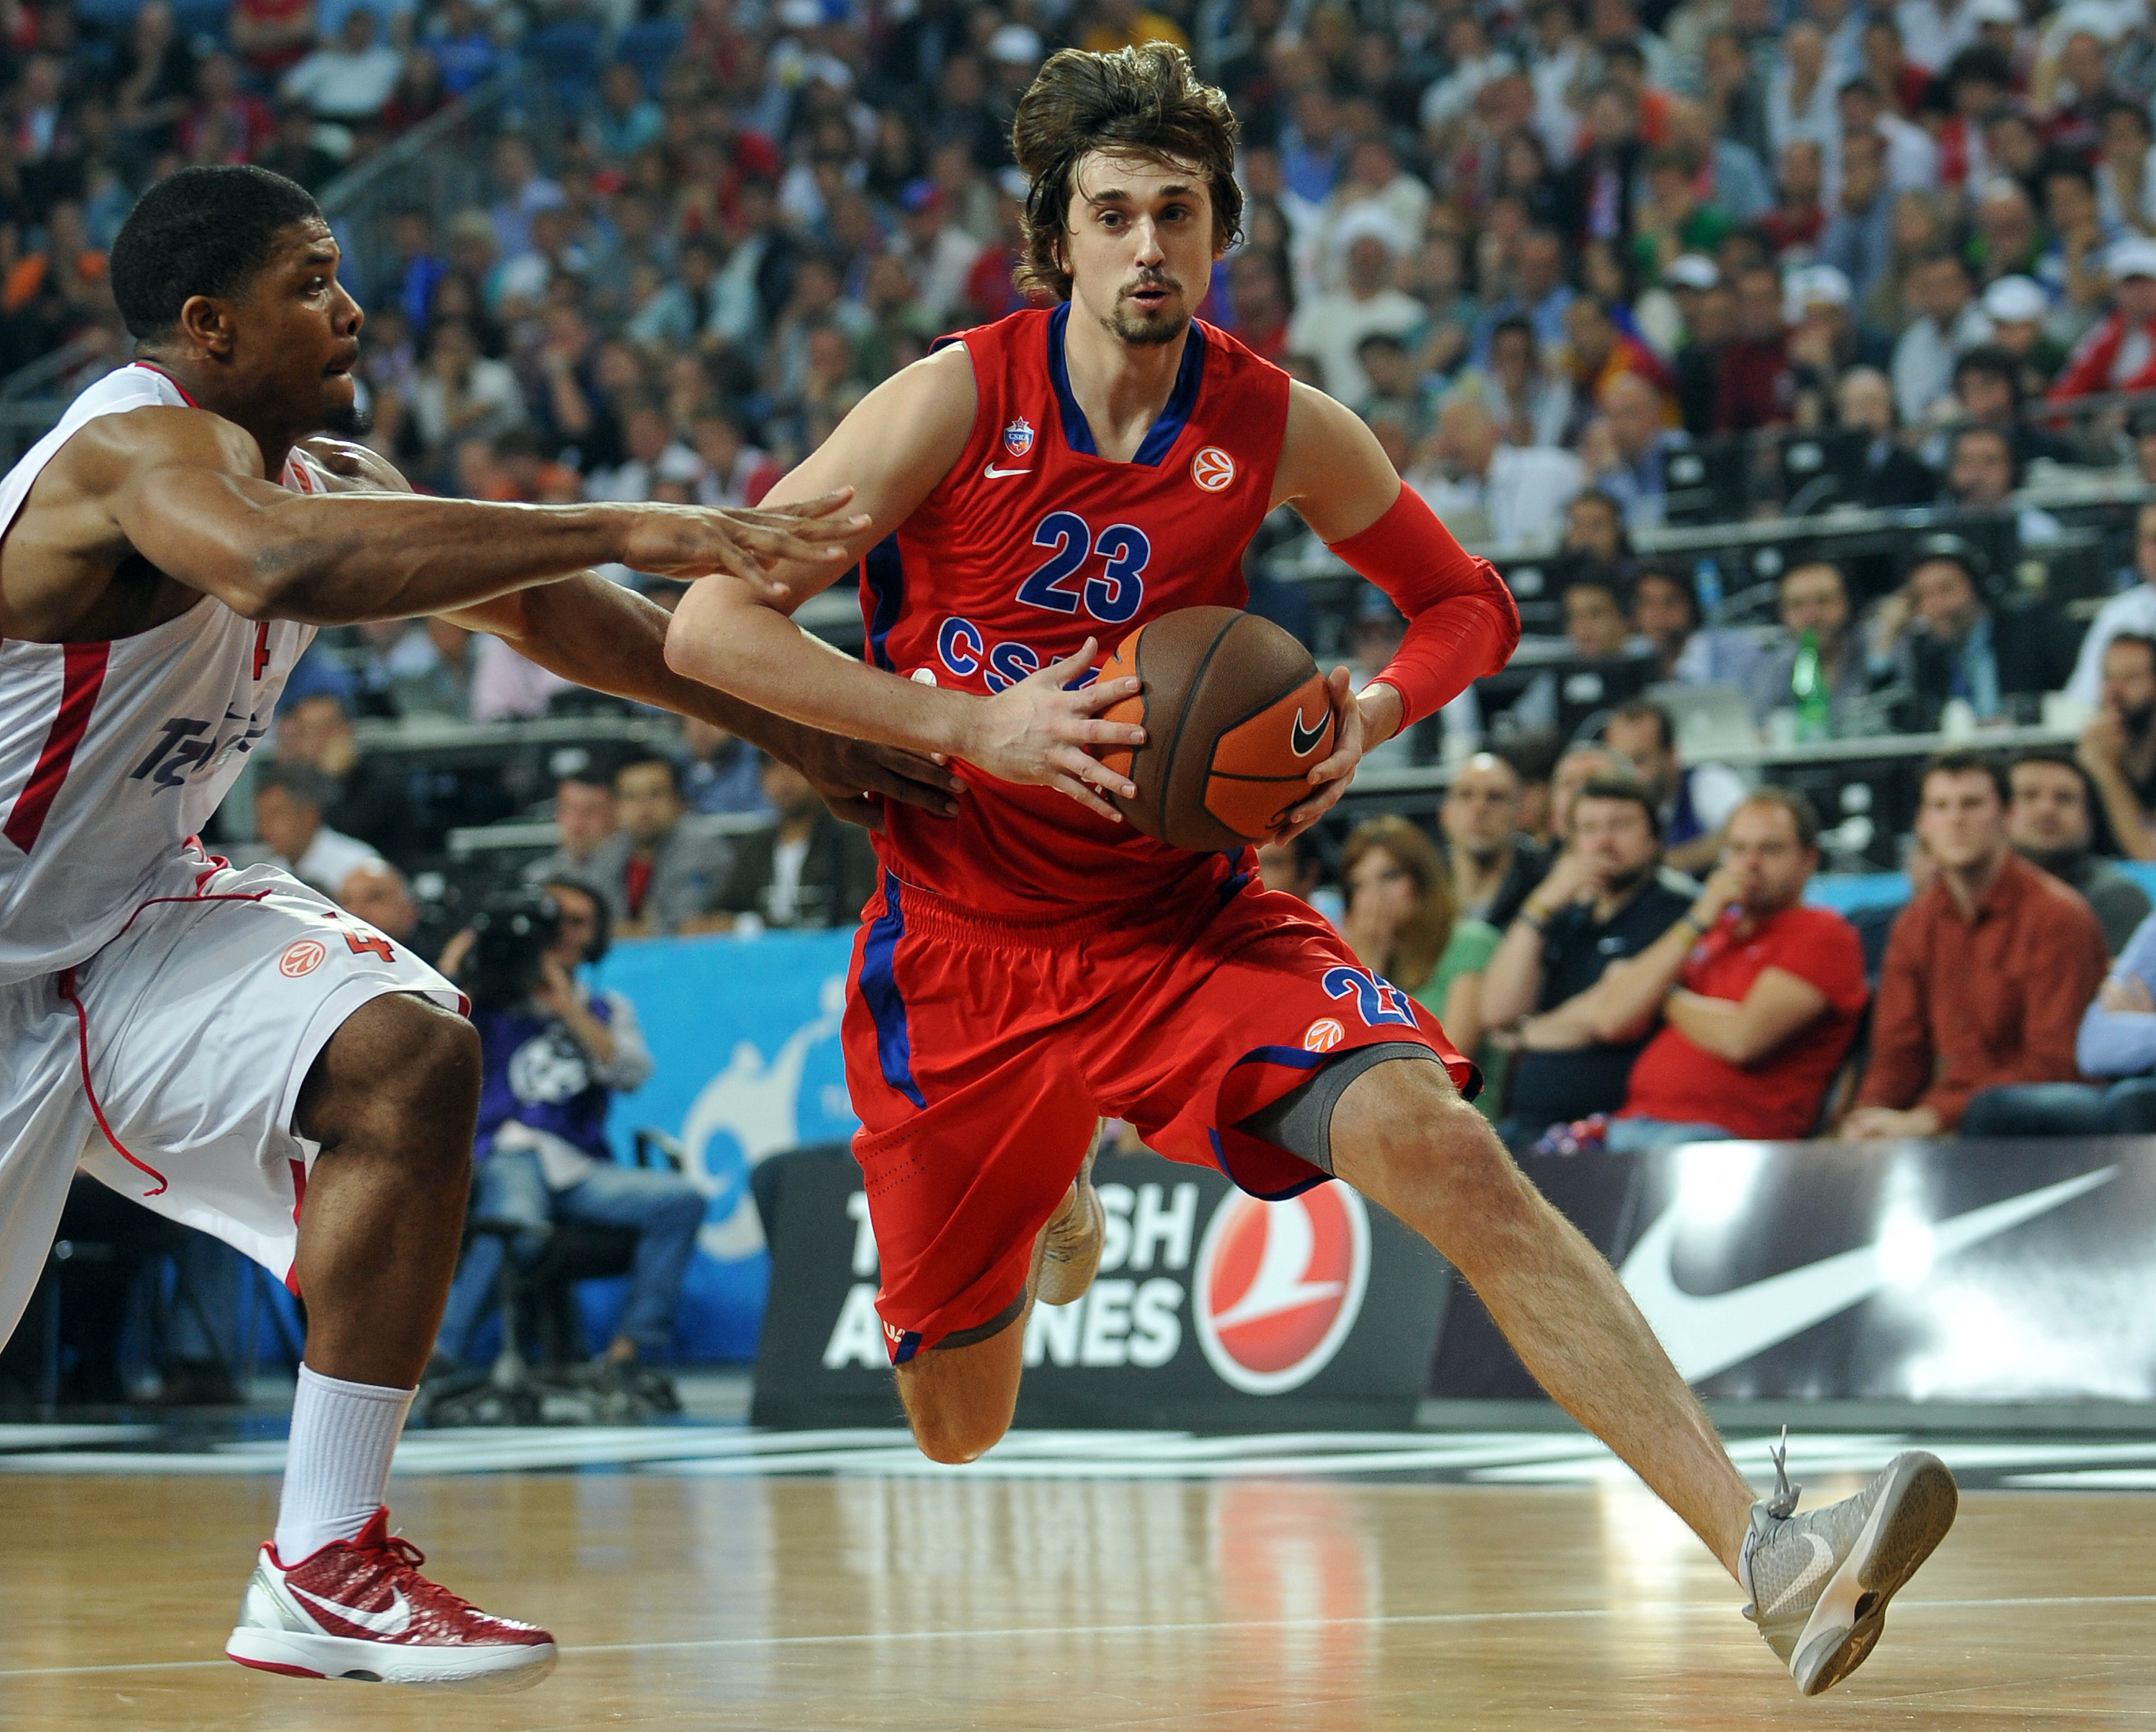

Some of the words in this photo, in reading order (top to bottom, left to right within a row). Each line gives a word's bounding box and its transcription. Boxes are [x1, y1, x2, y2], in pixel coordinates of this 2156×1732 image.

[1015, 510, 1151, 624] 23
[937, 617, 1102, 694] CS
[821, 1277, 1185, 1370] ANES
